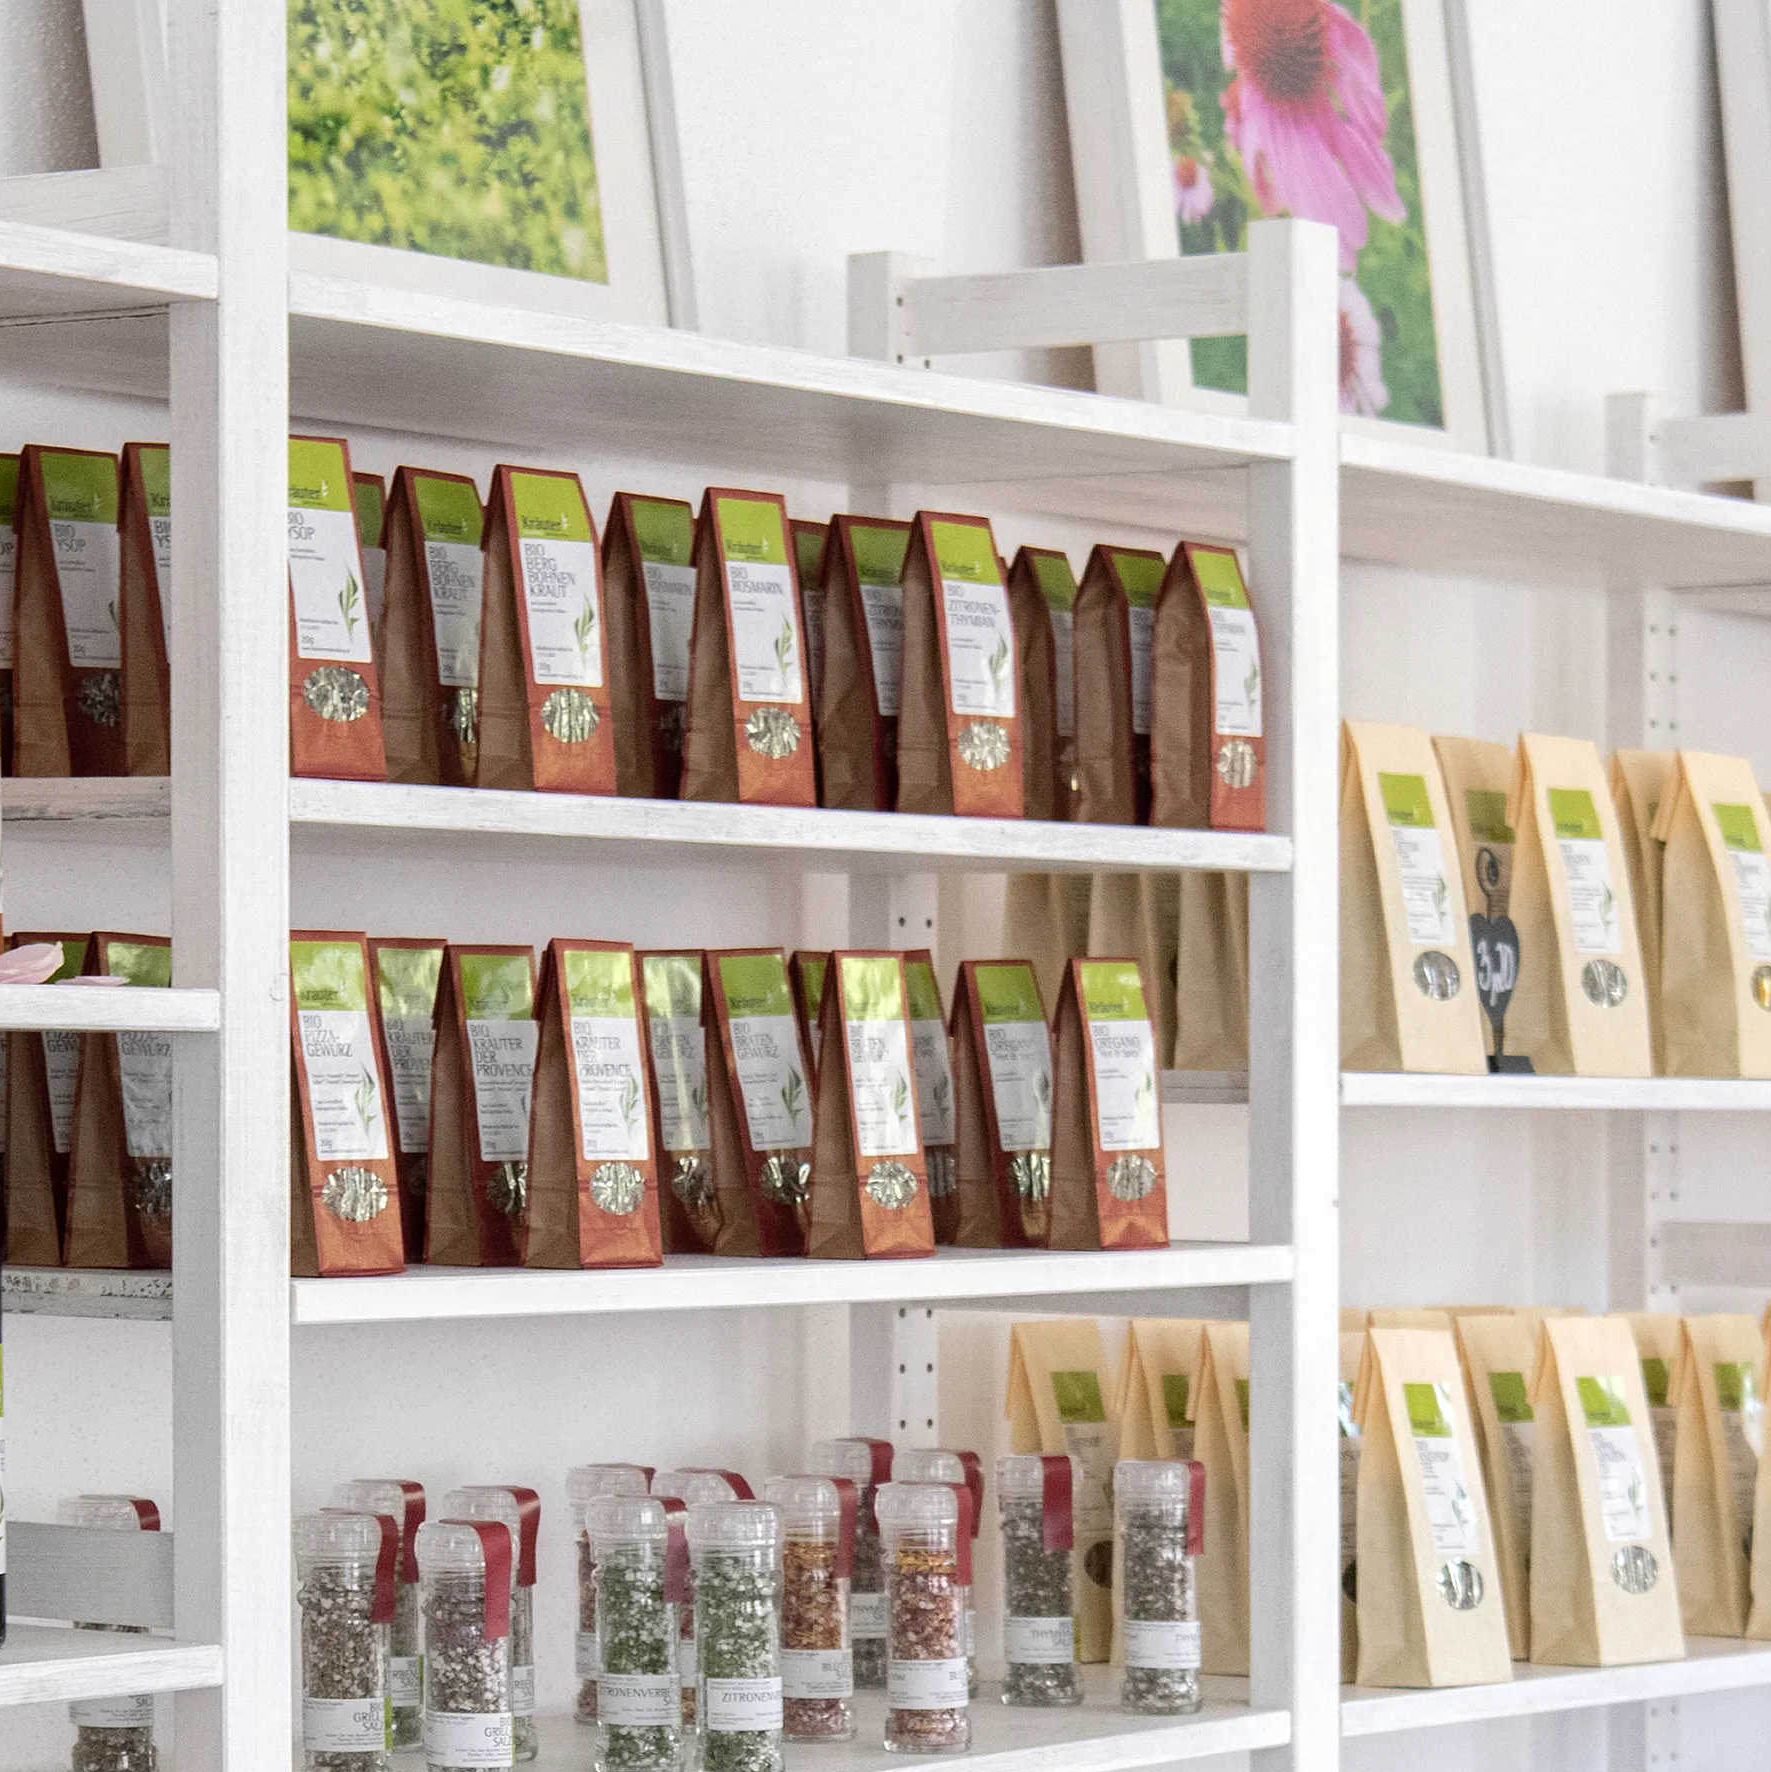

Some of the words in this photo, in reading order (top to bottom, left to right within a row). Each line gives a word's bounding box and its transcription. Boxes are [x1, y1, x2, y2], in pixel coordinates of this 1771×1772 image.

[524, 543, 546, 557] BIO
[525, 556, 557, 571] BERG
[528, 570, 576, 585] BOHNEN
[530, 584, 568, 599] KRAUT
[303, 1014, 322, 1028] BIO
[470, 1023, 490, 1038] BIO
[476, 1050, 498, 1064] DER
